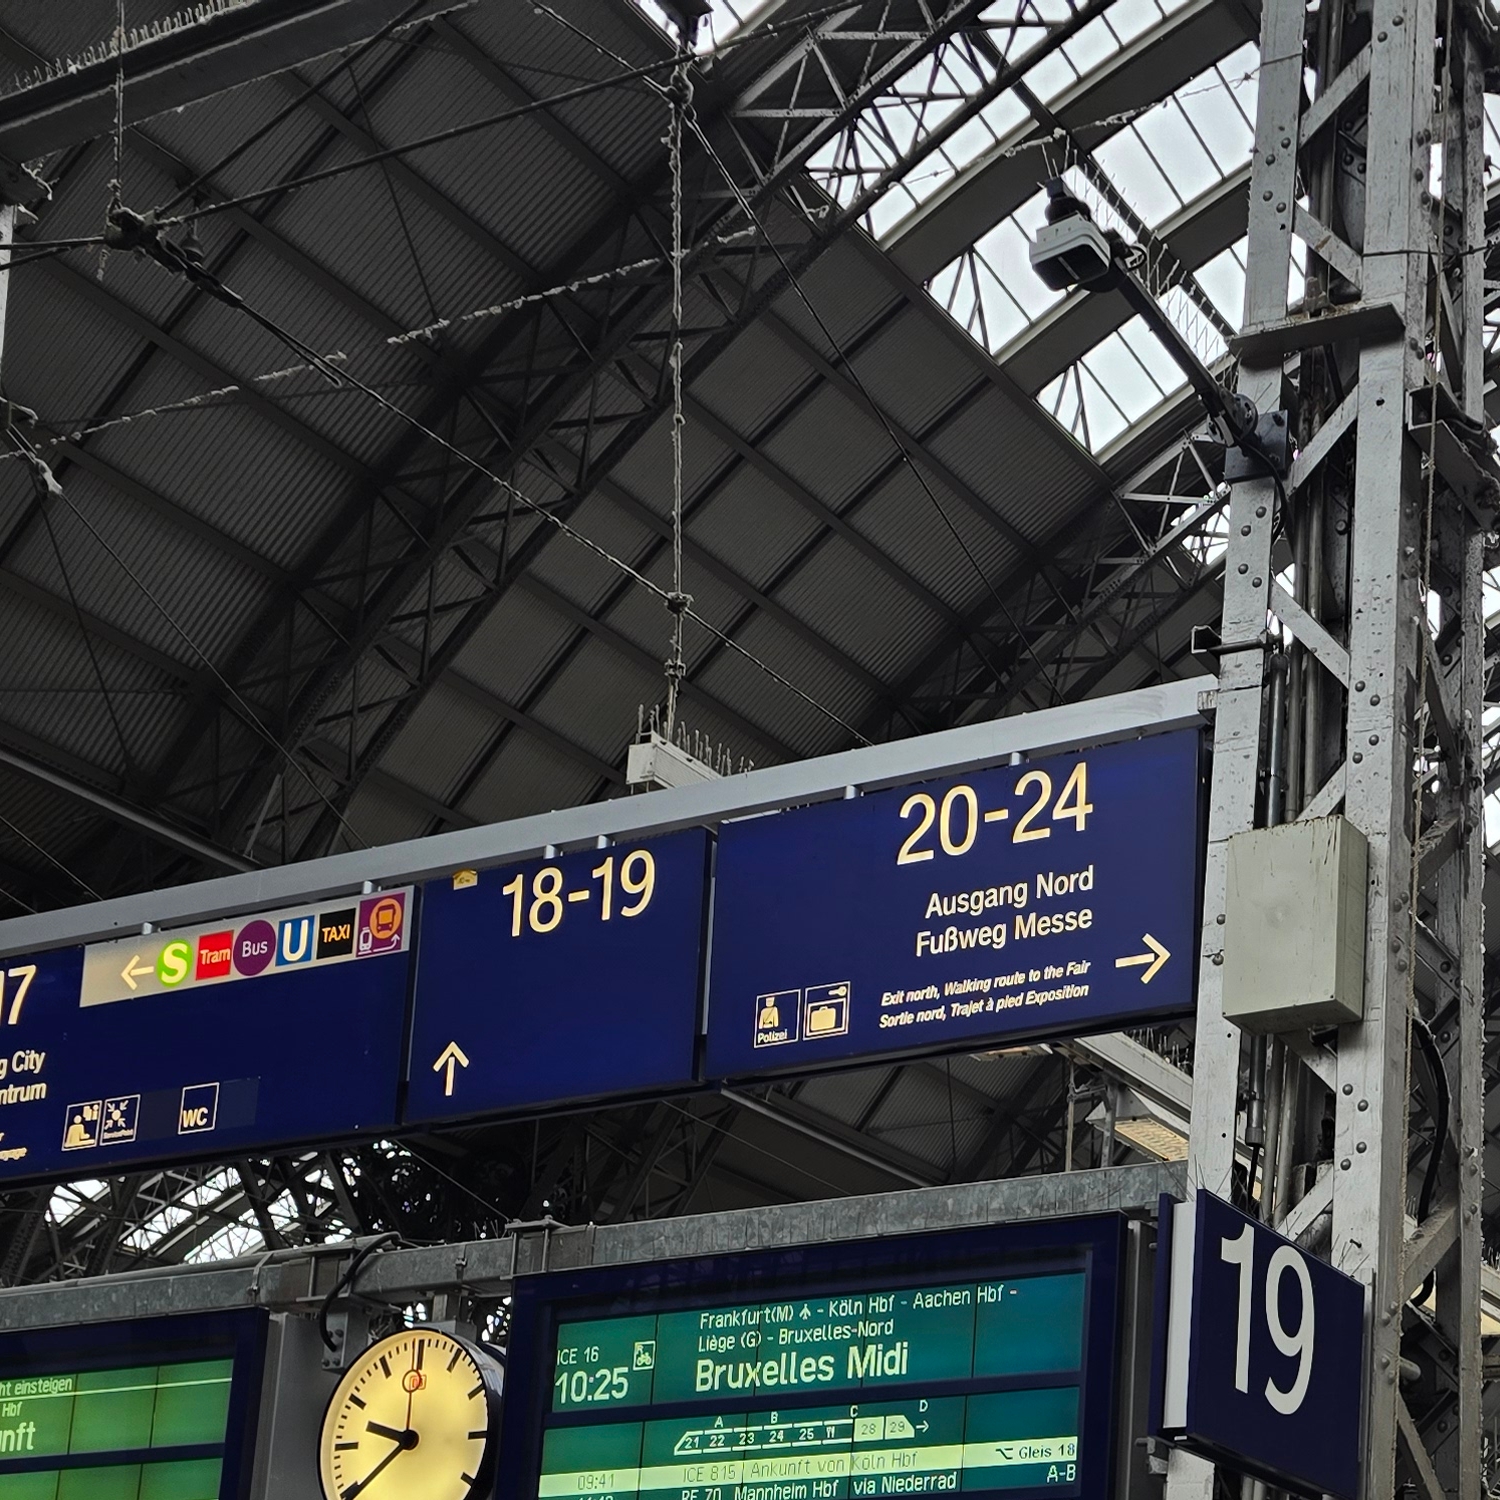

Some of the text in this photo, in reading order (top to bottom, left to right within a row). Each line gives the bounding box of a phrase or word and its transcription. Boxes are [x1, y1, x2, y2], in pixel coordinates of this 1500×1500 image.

[897, 761, 1094, 865] 20-24
[503, 850, 656, 937] 18-19
[925, 865, 1094, 918] Ausgang Nord
[161, 920, 350, 984] S Tram Bus U TAXI
[916, 908, 1093, 957] Fußweg Messe
[0, 964, 37, 1026] 7
[881, 960, 1091, 1006] Exit north, Walking route to the Fair
[879, 984, 1089, 1028] Sortie nord, Trajet à pied Exposition
[757, 1029, 787, 1044] Polizei
[12, 1050, 46, 1074] City
[183, 1108, 208, 1128] WC
[700, 1284, 1005, 1330] Frankfurt(M) Köln Hbf Aachen Hbf
[1220, 1222, 1315, 1415] 19
[557, 1346, 599, 1366] ICE 16
[698, 1319, 894, 1353] Liège (G) Bruxelles-Nord
[14, 1378, 73, 1395] einsteigen
[554, 1366, 630, 1405] 10:25
[696, 1341, 909, 1393] Bruxelles Midi
[2, 1401, 23, 1417] Hbf
[714, 1400, 928, 1428] A B C D
[0, 1421, 36, 1453] nft
[685, 1436, 700, 1449] 21
[710, 1435, 725, 1447] 22
[739, 1432, 755, 1445] 23
[769, 1430, 784, 1443] 24
[799, 1428, 814, 1441] 25
[861, 1423, 876, 1436] 28
[577, 1473, 615, 1491] 09:41
[683, 1467, 704, 1483] ICE
[751, 1459, 810, 1477] Ankunft
[818, 1458, 845, 1473] von
[850, 1454, 885, 1471] Köln
[892, 1451, 917, 1468] Hbf
[1019, 1445, 1051, 1460] Gleis
[812, 1479, 839, 1499] Hbf
[853, 1477, 876, 1495] via
[881, 1471, 957, 1493] Niederrad
[1046, 1464, 1076, 1483] A-B
